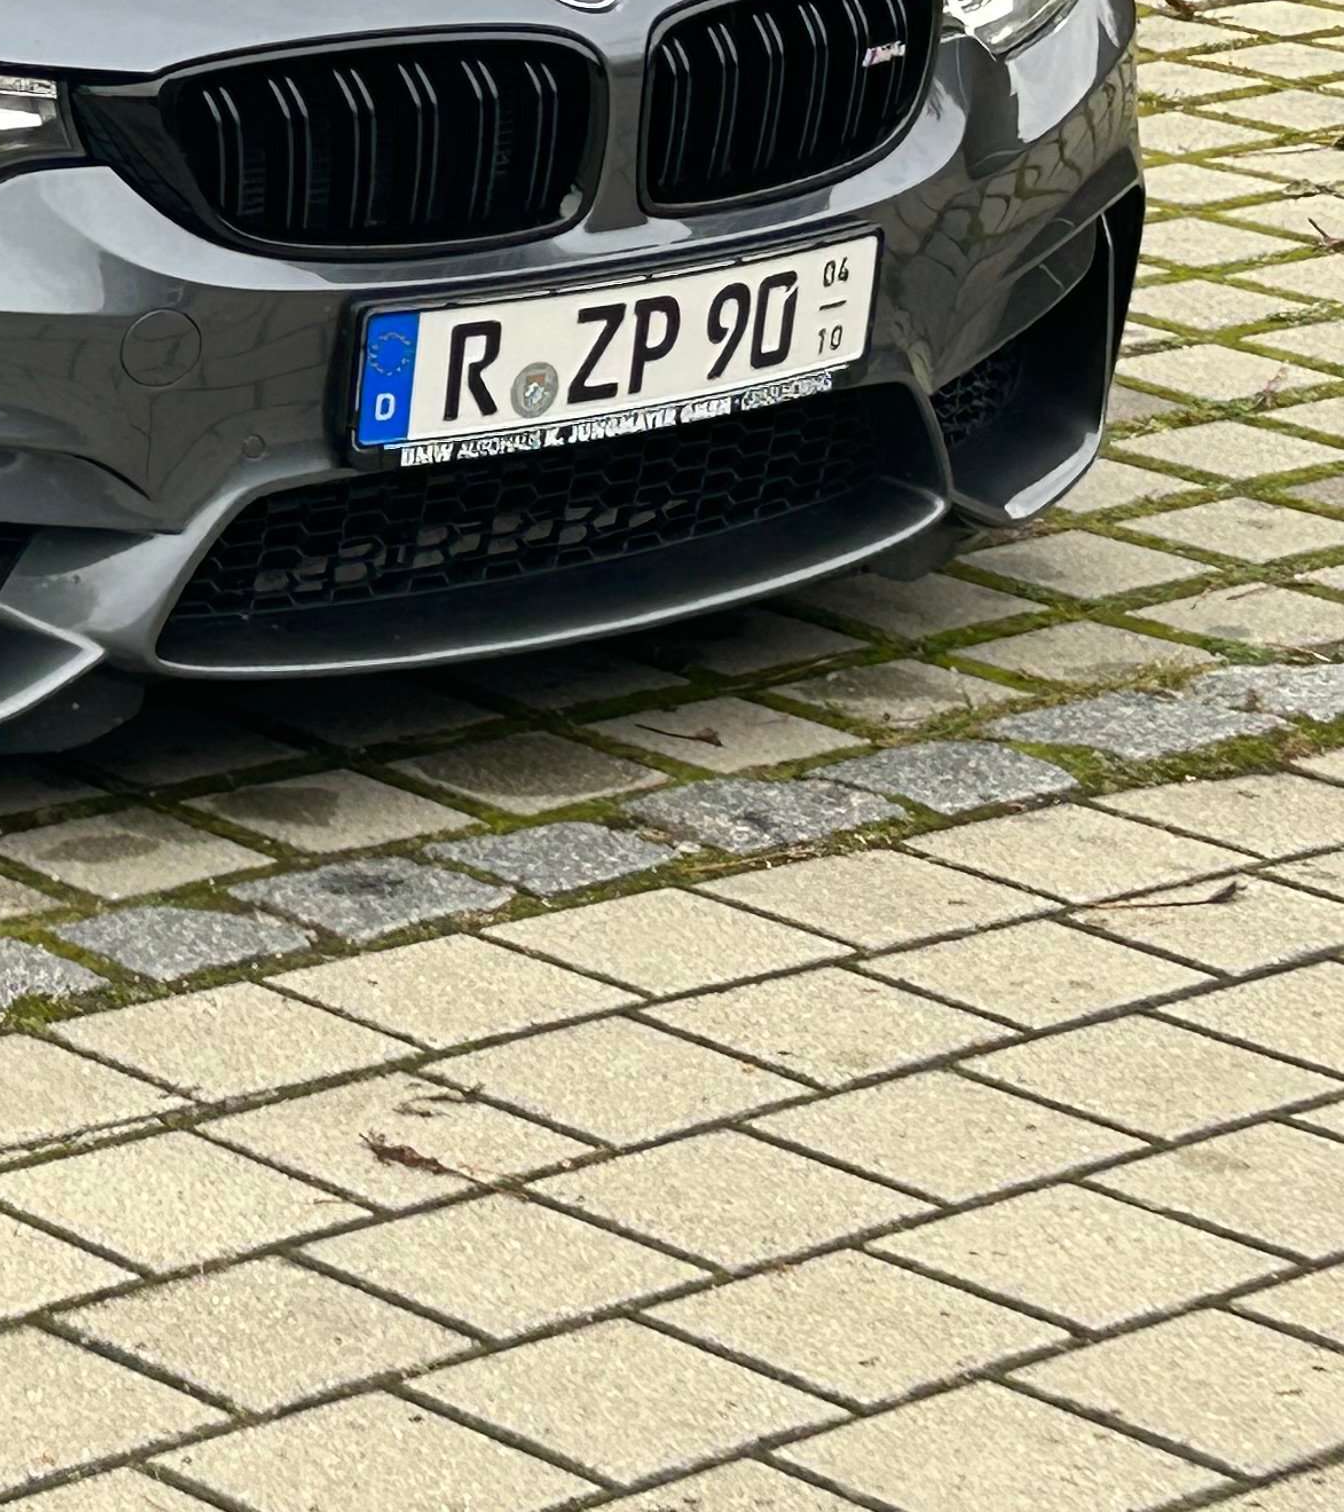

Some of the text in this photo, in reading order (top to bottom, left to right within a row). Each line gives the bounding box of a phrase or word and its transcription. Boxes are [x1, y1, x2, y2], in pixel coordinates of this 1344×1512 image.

[442, 270, 800, 422] R ZP 90
[817, 324, 843, 355] 10
[374, 392, 396, 422] D
